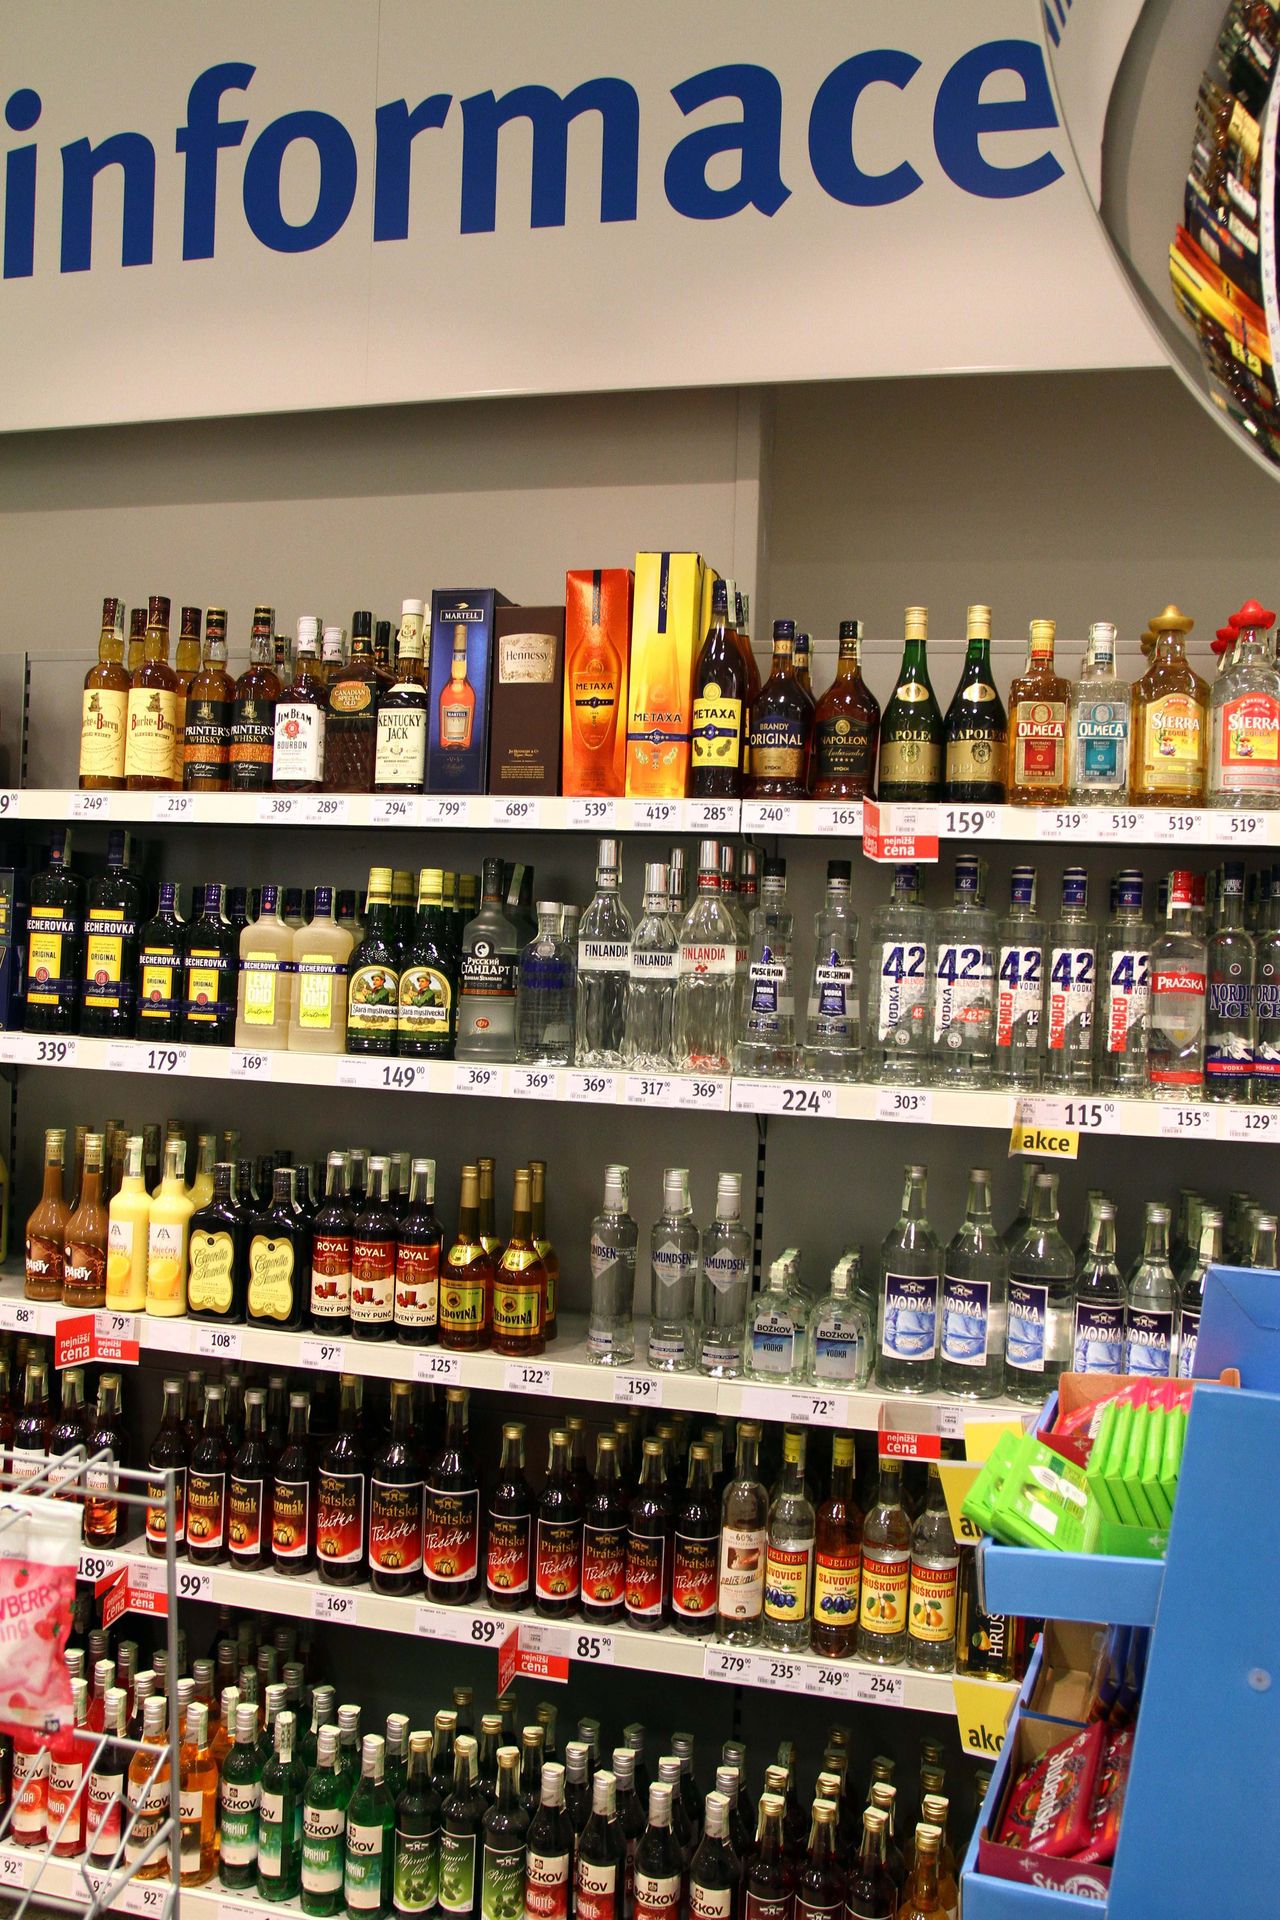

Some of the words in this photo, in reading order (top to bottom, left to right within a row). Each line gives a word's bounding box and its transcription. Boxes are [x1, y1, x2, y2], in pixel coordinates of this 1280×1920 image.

[3, 38, 1066, 279] informace
[444, 610, 479, 620] MARTELL
[506, 650, 549, 662] Hennessy
[576, 682, 613, 690] METAXA
[276, 711, 288, 726] JIM
[290, 708, 312, 725] BEAM
[634, 713, 682, 722] METAXA
[694, 709, 736, 719] METAXA
[378, 715, 422, 727] KENTUCKY
[760, 723, 789, 731] BRANDY
[1152, 714, 1199, 731] SIERRA
[1229, 714, 1279, 730] SIERRA
[185, 725, 230, 737] PRINTER'S
[386, 729, 408, 743] JACK
[1018, 723, 1063, 737] OLMECA
[1079, 723, 1124, 737] OLMECA
[189, 735, 221, 744] WHISKY
[234, 734, 265, 743] WHISKY
[751, 733, 802, 746] ORIGINAL
[277, 741, 307, 749] BOURBON
[884, 836, 915, 845] nejnižší
[884, 843, 915, 856] cena
[32, 950, 56, 959] ORIGINAL
[91, 952, 116, 962] ORIGINAL
[585, 944, 629, 958] FINLANDIA
[682, 947, 725, 961] FINLANDIA
[140, 955, 181, 966] BECHEROVKA
[185, 957, 227, 968] BECHEROVKA
[244, 962, 280, 970] BECHEROVKA
[467, 956, 499, 965] Русский
[633, 954, 673, 966] FINLANDIA
[883, 946, 925, 981] 42
[299, 963, 337, 973] BECHEROVKA
[461, 962, 510, 975] СТАНДАРТ
[751, 967, 783, 977] PUSCHKIN
[938, 949, 982, 984] 42
[1001, 950, 1041, 989] 42
[1052, 952, 1094, 991] 42
[819, 969, 850, 980] PUSCHKIN
[1111, 955, 1149, 994] 42
[1019, 983, 1040, 991] VODKA
[1072, 983, 1093, 993] VODKA
[1157, 974, 1204, 991] PRAŽSKÁ
[888, 986, 900, 1027] VODKA
[941, 988, 951, 1030] VODKA
[1219, 1002, 1250, 1019] ICE
[1023, 1132, 1070, 1151] akce
[317, 1242, 349, 1252] ROYAL
[355, 1246, 385, 1257] ROYAL
[398, 1249, 429, 1261] ROYAL
[652, 1252, 692, 1265] AMUNDSEN
[26, 1259, 48, 1273] PARTY
[704, 1257, 745, 1271] AMUNDSEN
[65, 1266, 92, 1281] PARTY
[890, 1294, 932, 1312] VODKA
[943, 1296, 983, 1317] VODKA
[416, 1314, 435, 1322] PUNČ
[757, 1323, 791, 1334] BOŽKOV
[1080, 1325, 1121, 1344] VODKA
[61, 1333, 91, 1348] nejnižší
[820, 1330, 855, 1340] BOŽKOV
[97, 1339, 121, 1348] nejnižší
[763, 1343, 783, 1352] VODKA
[61, 1347, 90, 1362] cena
[97, 1346, 121, 1358] cena
[826, 1349, 846, 1359] VODKA
[886, 1435, 917, 1444] nejnižší
[886, 1442, 917, 1454] cena
[373, 1502, 418, 1517] Pirátská
[426, 1509, 472, 1525] Pirátská
[489, 1533, 525, 1547] Pirátská
[736, 1533, 753, 1541] 60%
[677, 1555, 715, 1568] Pirátská
[870, 1563, 906, 1573] JELÍNEK
[916, 1571, 953, 1582] JELÍNEK
[130, 1590, 154, 1601] nejnižší
[107, 1599, 125, 1620] cena
[130, 1598, 154, 1610] cena
[521, 1654, 548, 1663] nejnižší
[521, 1661, 548, 1674] cena
[969, 1725, 1005, 1751] akc
[1030, 1746, 1073, 1841] Studentská
